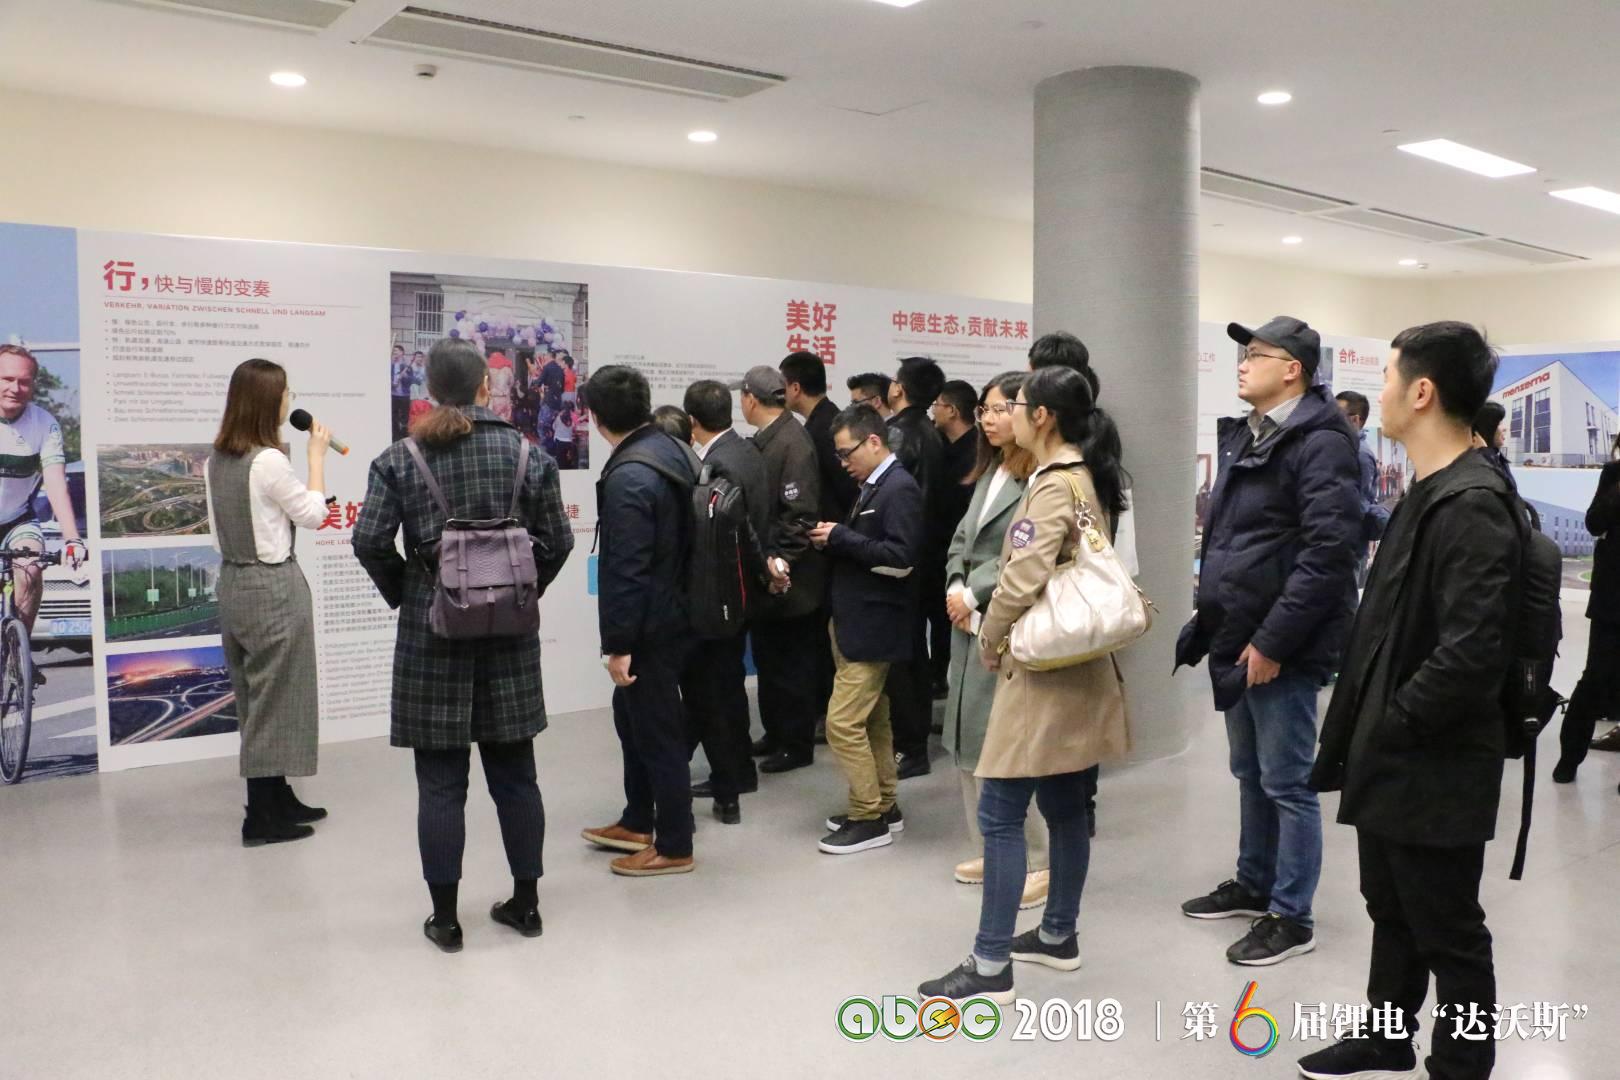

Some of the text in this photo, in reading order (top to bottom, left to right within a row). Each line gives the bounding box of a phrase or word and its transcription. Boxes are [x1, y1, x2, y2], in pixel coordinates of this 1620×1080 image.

[786, 300, 836, 332] 美好
[892, 310, 1028, 339] 中德生态，贡献未来
